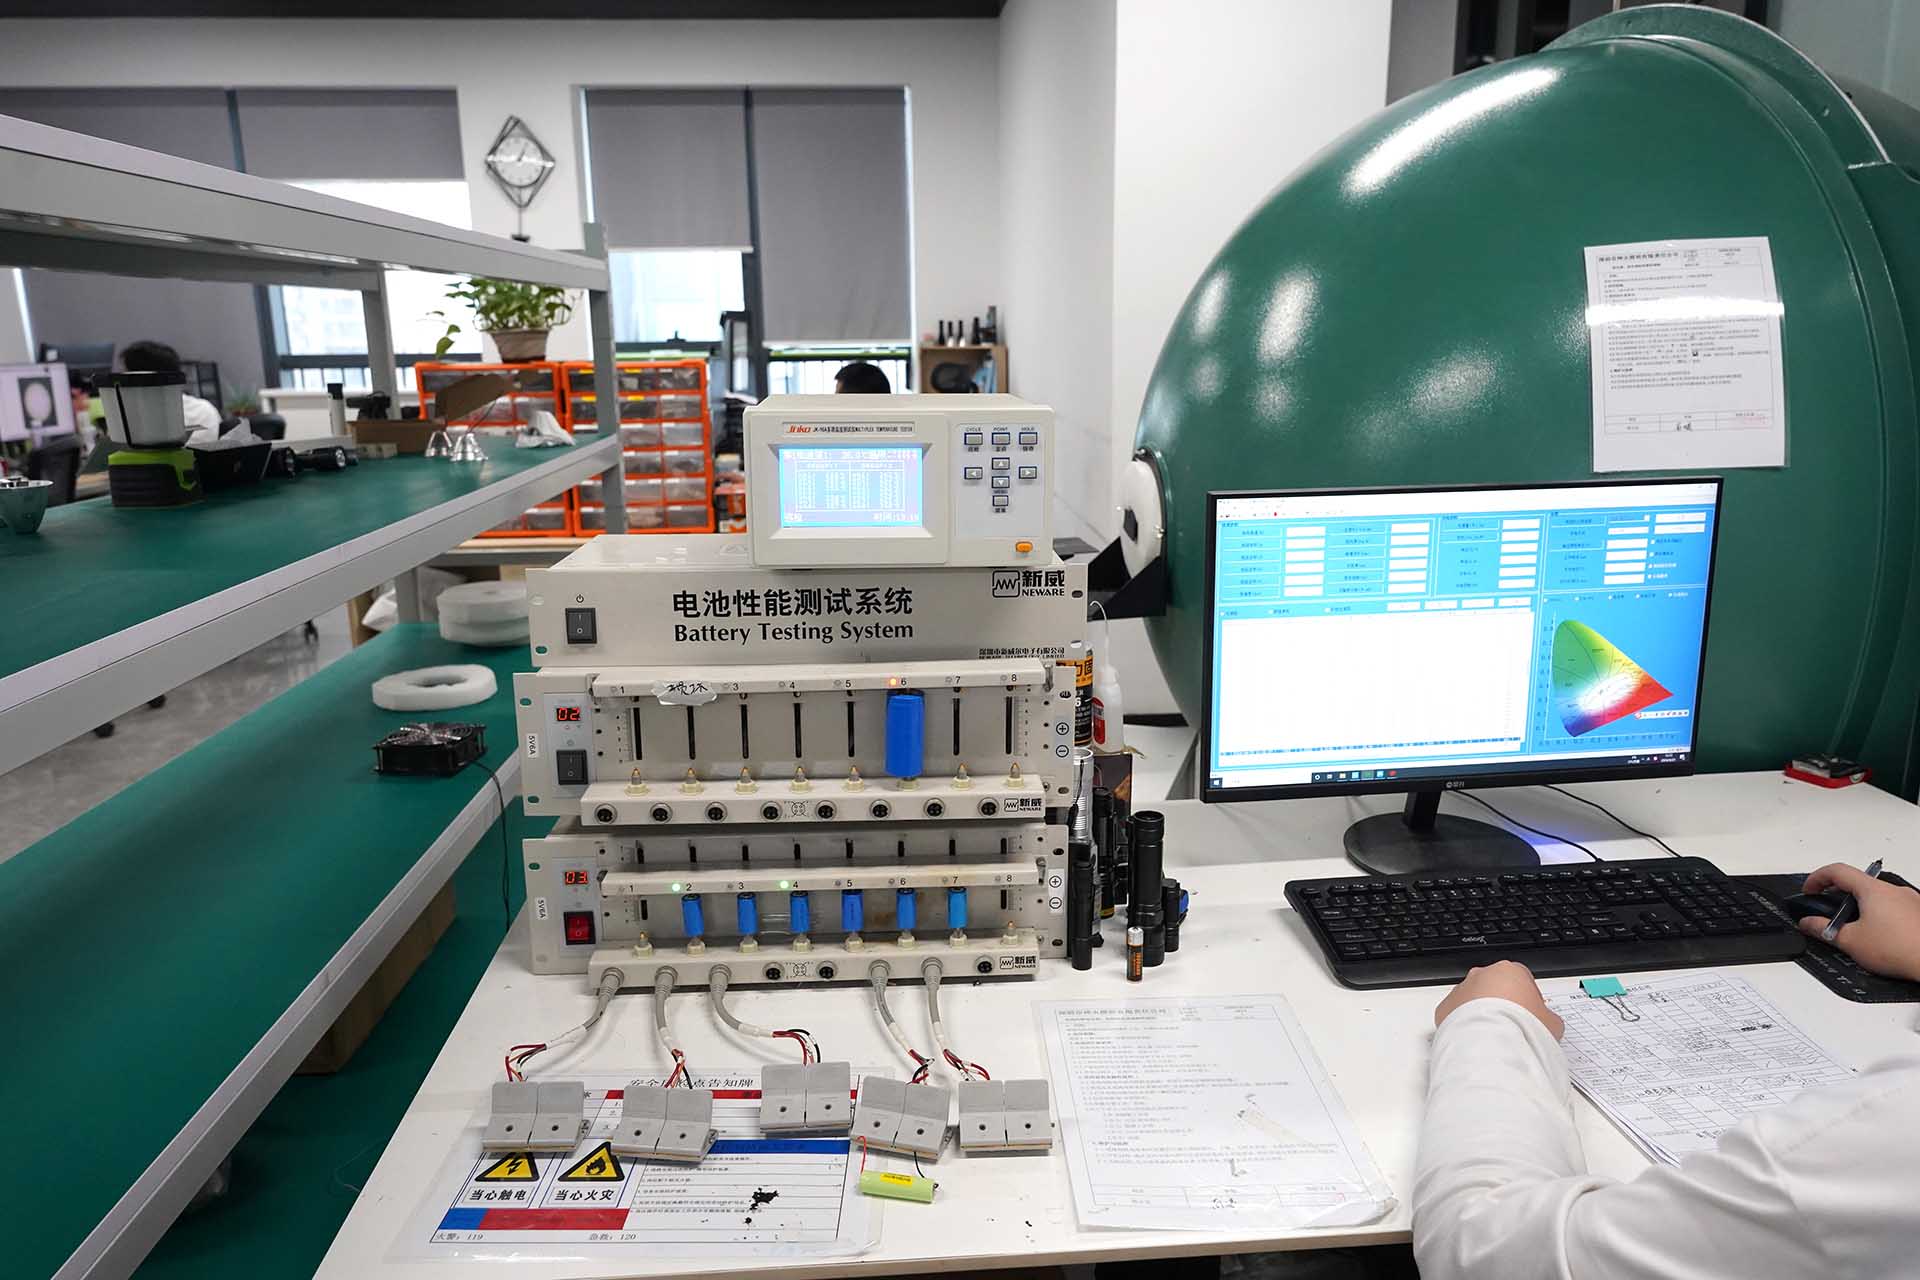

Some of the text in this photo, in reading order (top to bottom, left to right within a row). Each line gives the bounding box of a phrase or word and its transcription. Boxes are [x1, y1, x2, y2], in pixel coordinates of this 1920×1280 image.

[1021, 569, 1065, 587] 新威
[1021, 588, 1065, 597] NEWARE
[672, 587, 913, 618] 电池性能测试系统
[674, 620, 914, 645] Battery Testing System
[900, 678, 907, 686] 6
[954, 675, 961, 684] 7
[1011, 674, 1017, 682] 8
[732, 682, 739, 691] 3
[788, 681, 796, 689] 4
[845, 679, 852, 688] 5
[619, 686, 626, 694] 1
[528, 735, 537, 755] 5V6A
[792, 880, 799, 888] 4
[900, 878, 906, 886] 6
[952, 876, 959, 884] 7
[686, 882, 692, 891] 2
[738, 881, 745, 890] 3
[469, 1189, 528, 1201] 当心触电
[554, 1189, 615, 1202] 当心火灾
